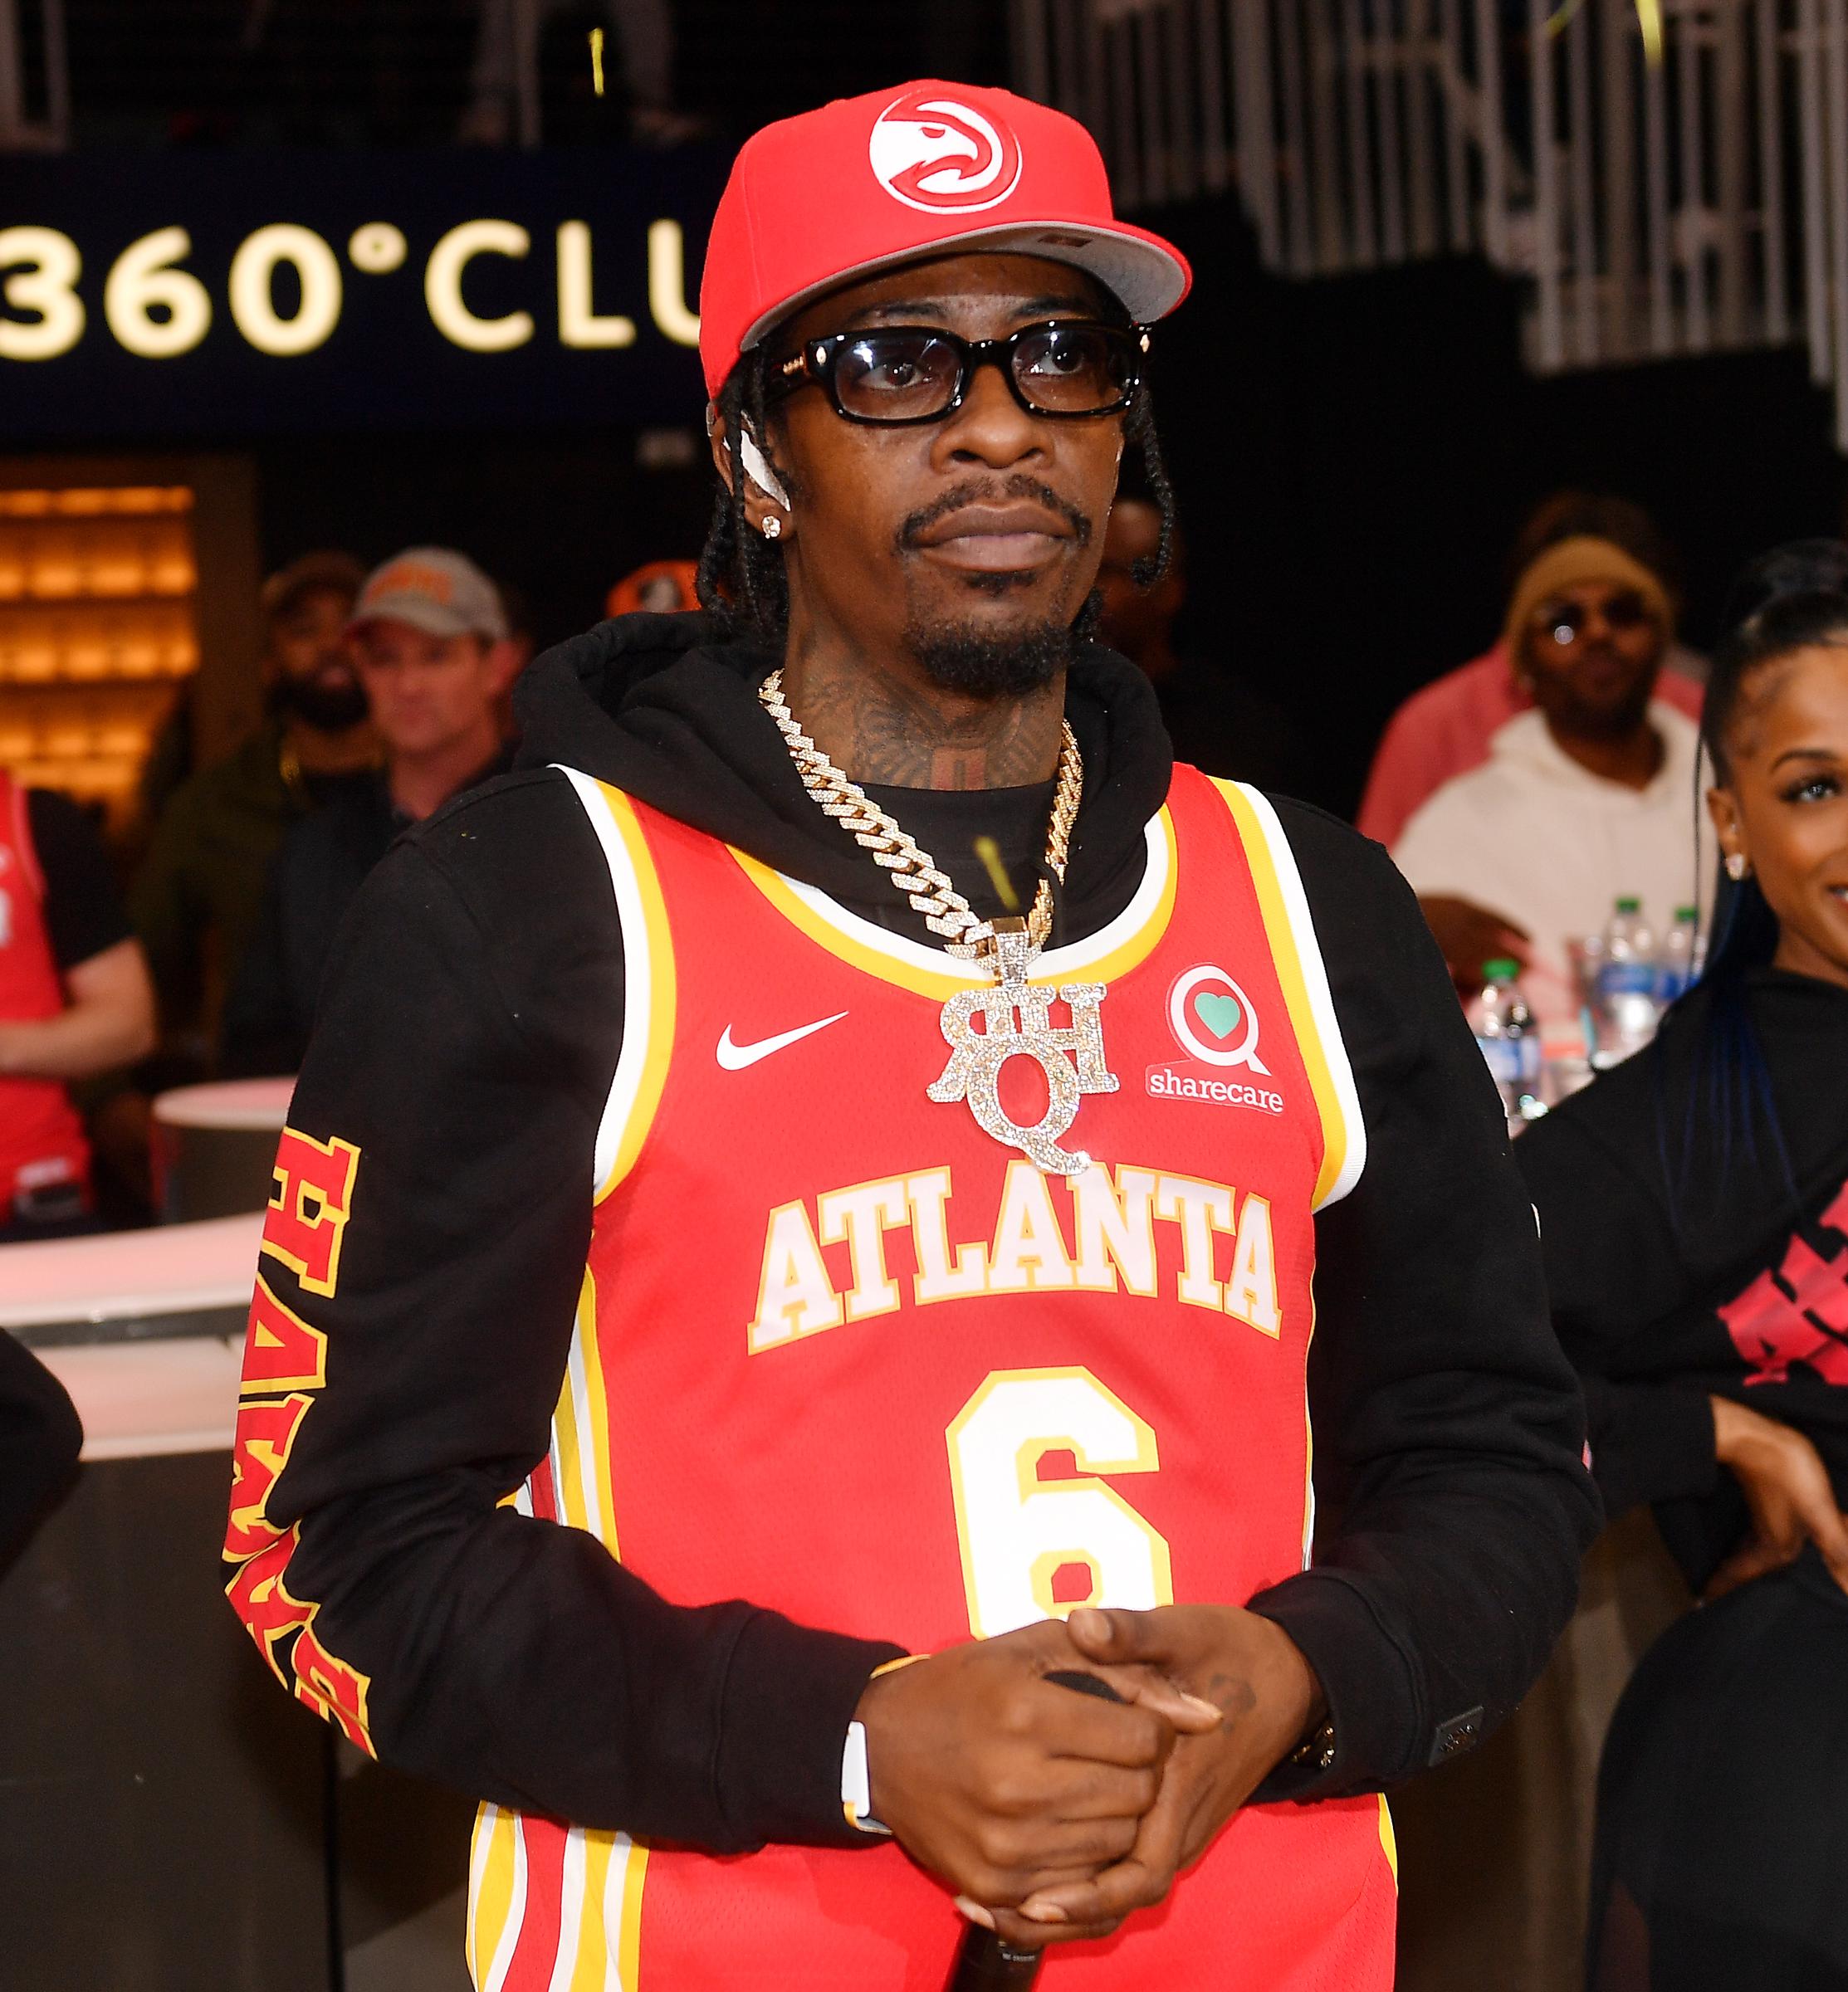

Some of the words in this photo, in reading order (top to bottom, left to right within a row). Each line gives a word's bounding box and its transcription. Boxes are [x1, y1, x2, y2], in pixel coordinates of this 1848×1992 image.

[1150, 1068, 1283, 1113] sharecare
[746, 1160, 1282, 1356] ATLANTA
[945, 1365, 1172, 1638] 6
